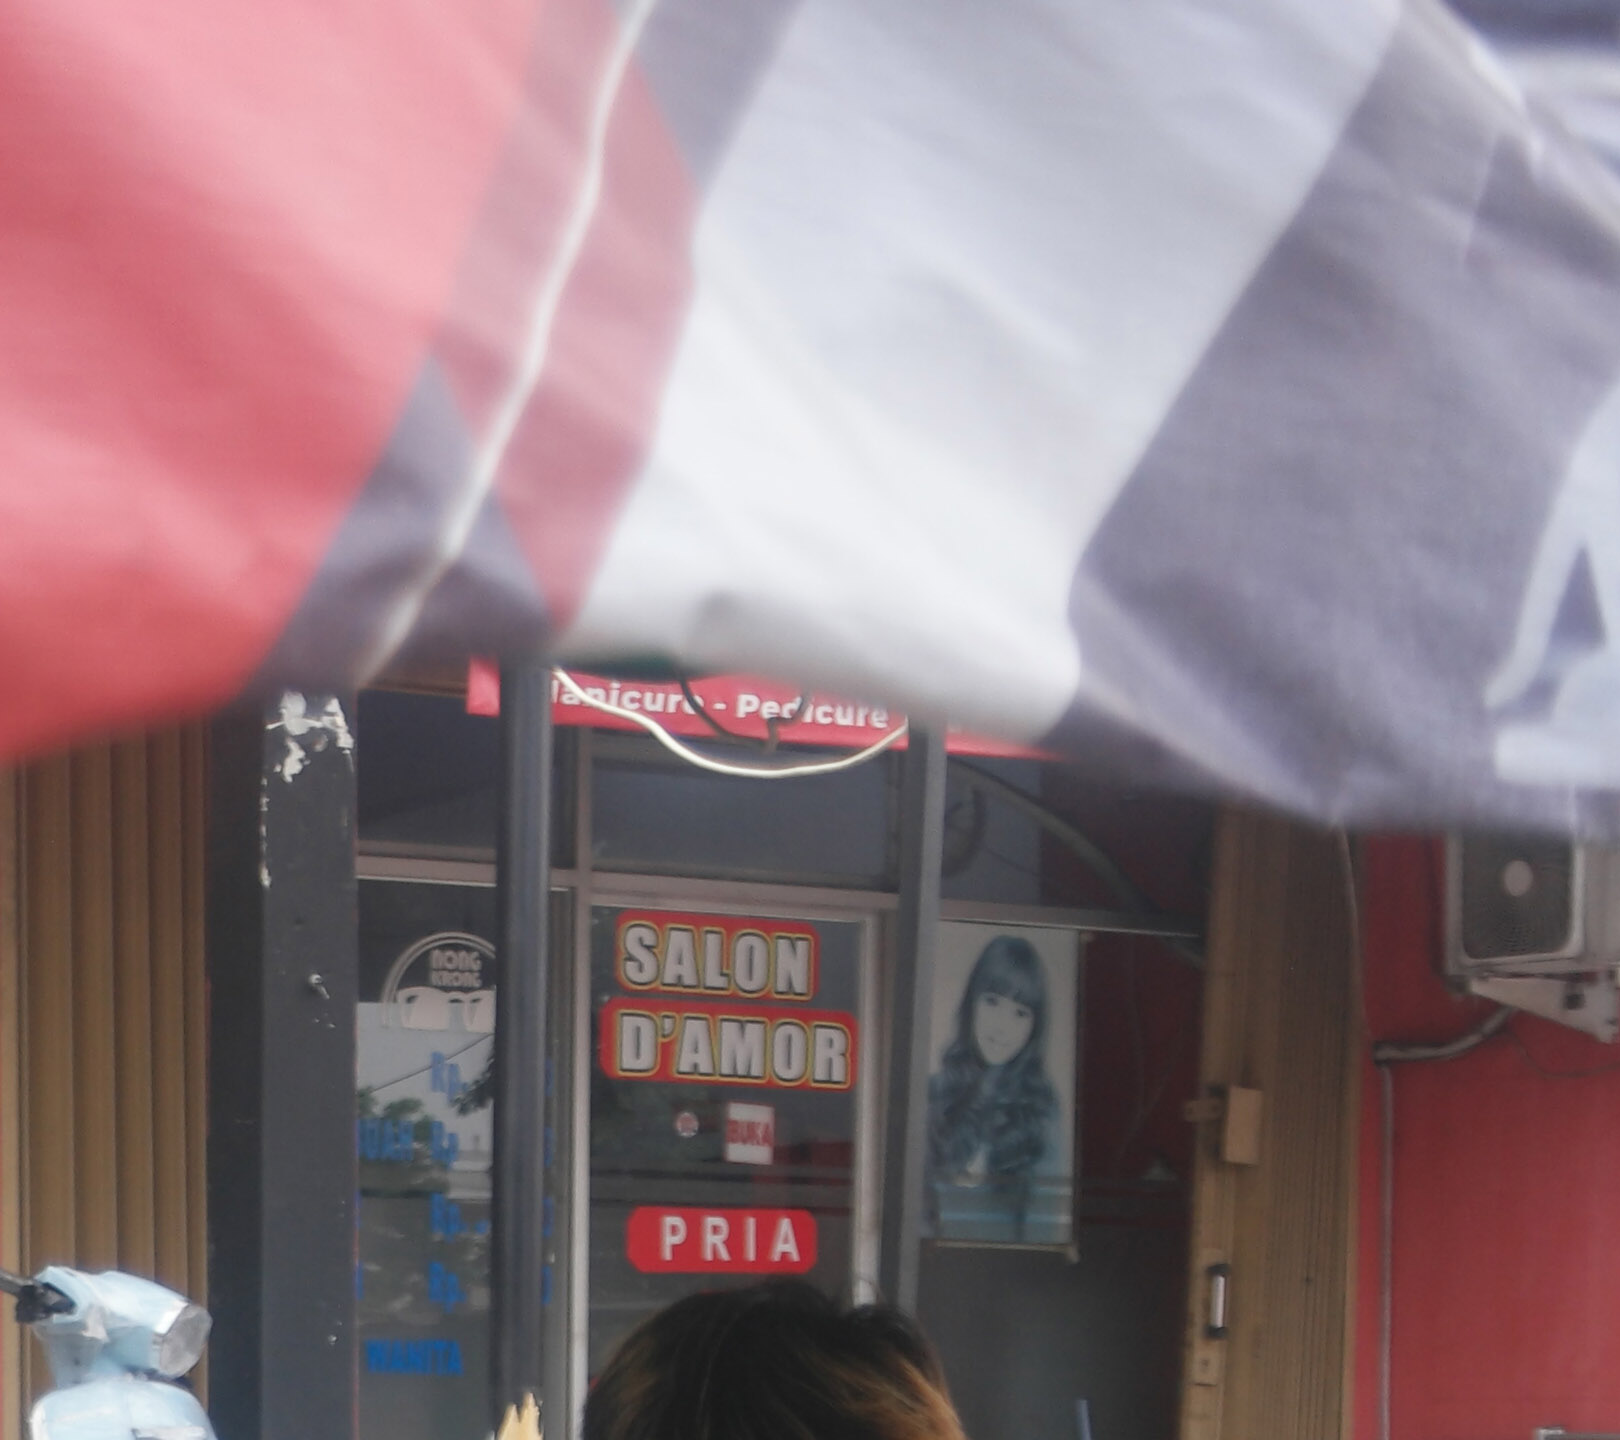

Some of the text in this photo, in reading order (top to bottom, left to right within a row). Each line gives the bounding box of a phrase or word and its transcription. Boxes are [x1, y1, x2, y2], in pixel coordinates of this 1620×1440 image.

[736, 693, 889, 728] Pedicure
[623, 922, 813, 997] SALON
[618, 1011, 850, 1087] D'AMOR
[661, 1215, 802, 1263] PRIA
